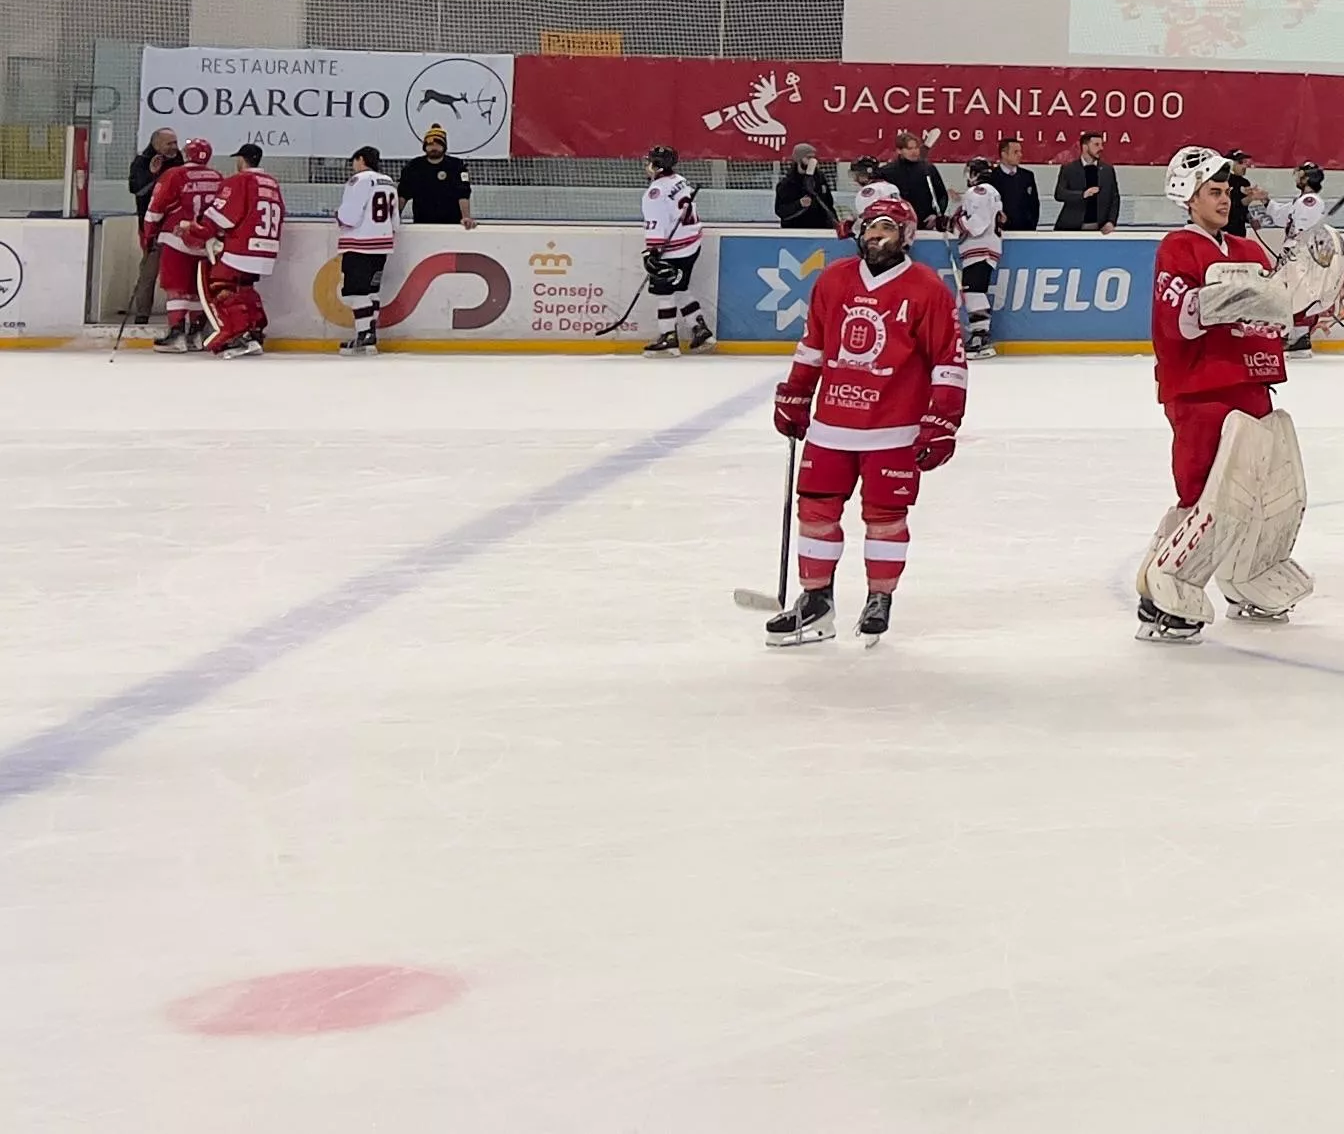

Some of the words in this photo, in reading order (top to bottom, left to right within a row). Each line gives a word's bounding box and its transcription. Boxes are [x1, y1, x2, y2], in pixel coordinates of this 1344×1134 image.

[202, 57, 338, 76] RESTAURANTE
[147, 86, 390, 119] COBARCHO
[823, 85, 1184, 119] JACETANIA2000
[247, 130, 290, 146] JACA
[878, 127, 1131, 143] INMOBILIAIA
[533, 283, 604, 297] Consejo
[1163, 276, 1189, 308] 30
[533, 301, 608, 315] Superior
[895, 299, 909, 323] A
[531, 318, 552, 331] de
[828, 383, 881, 403] uesca
